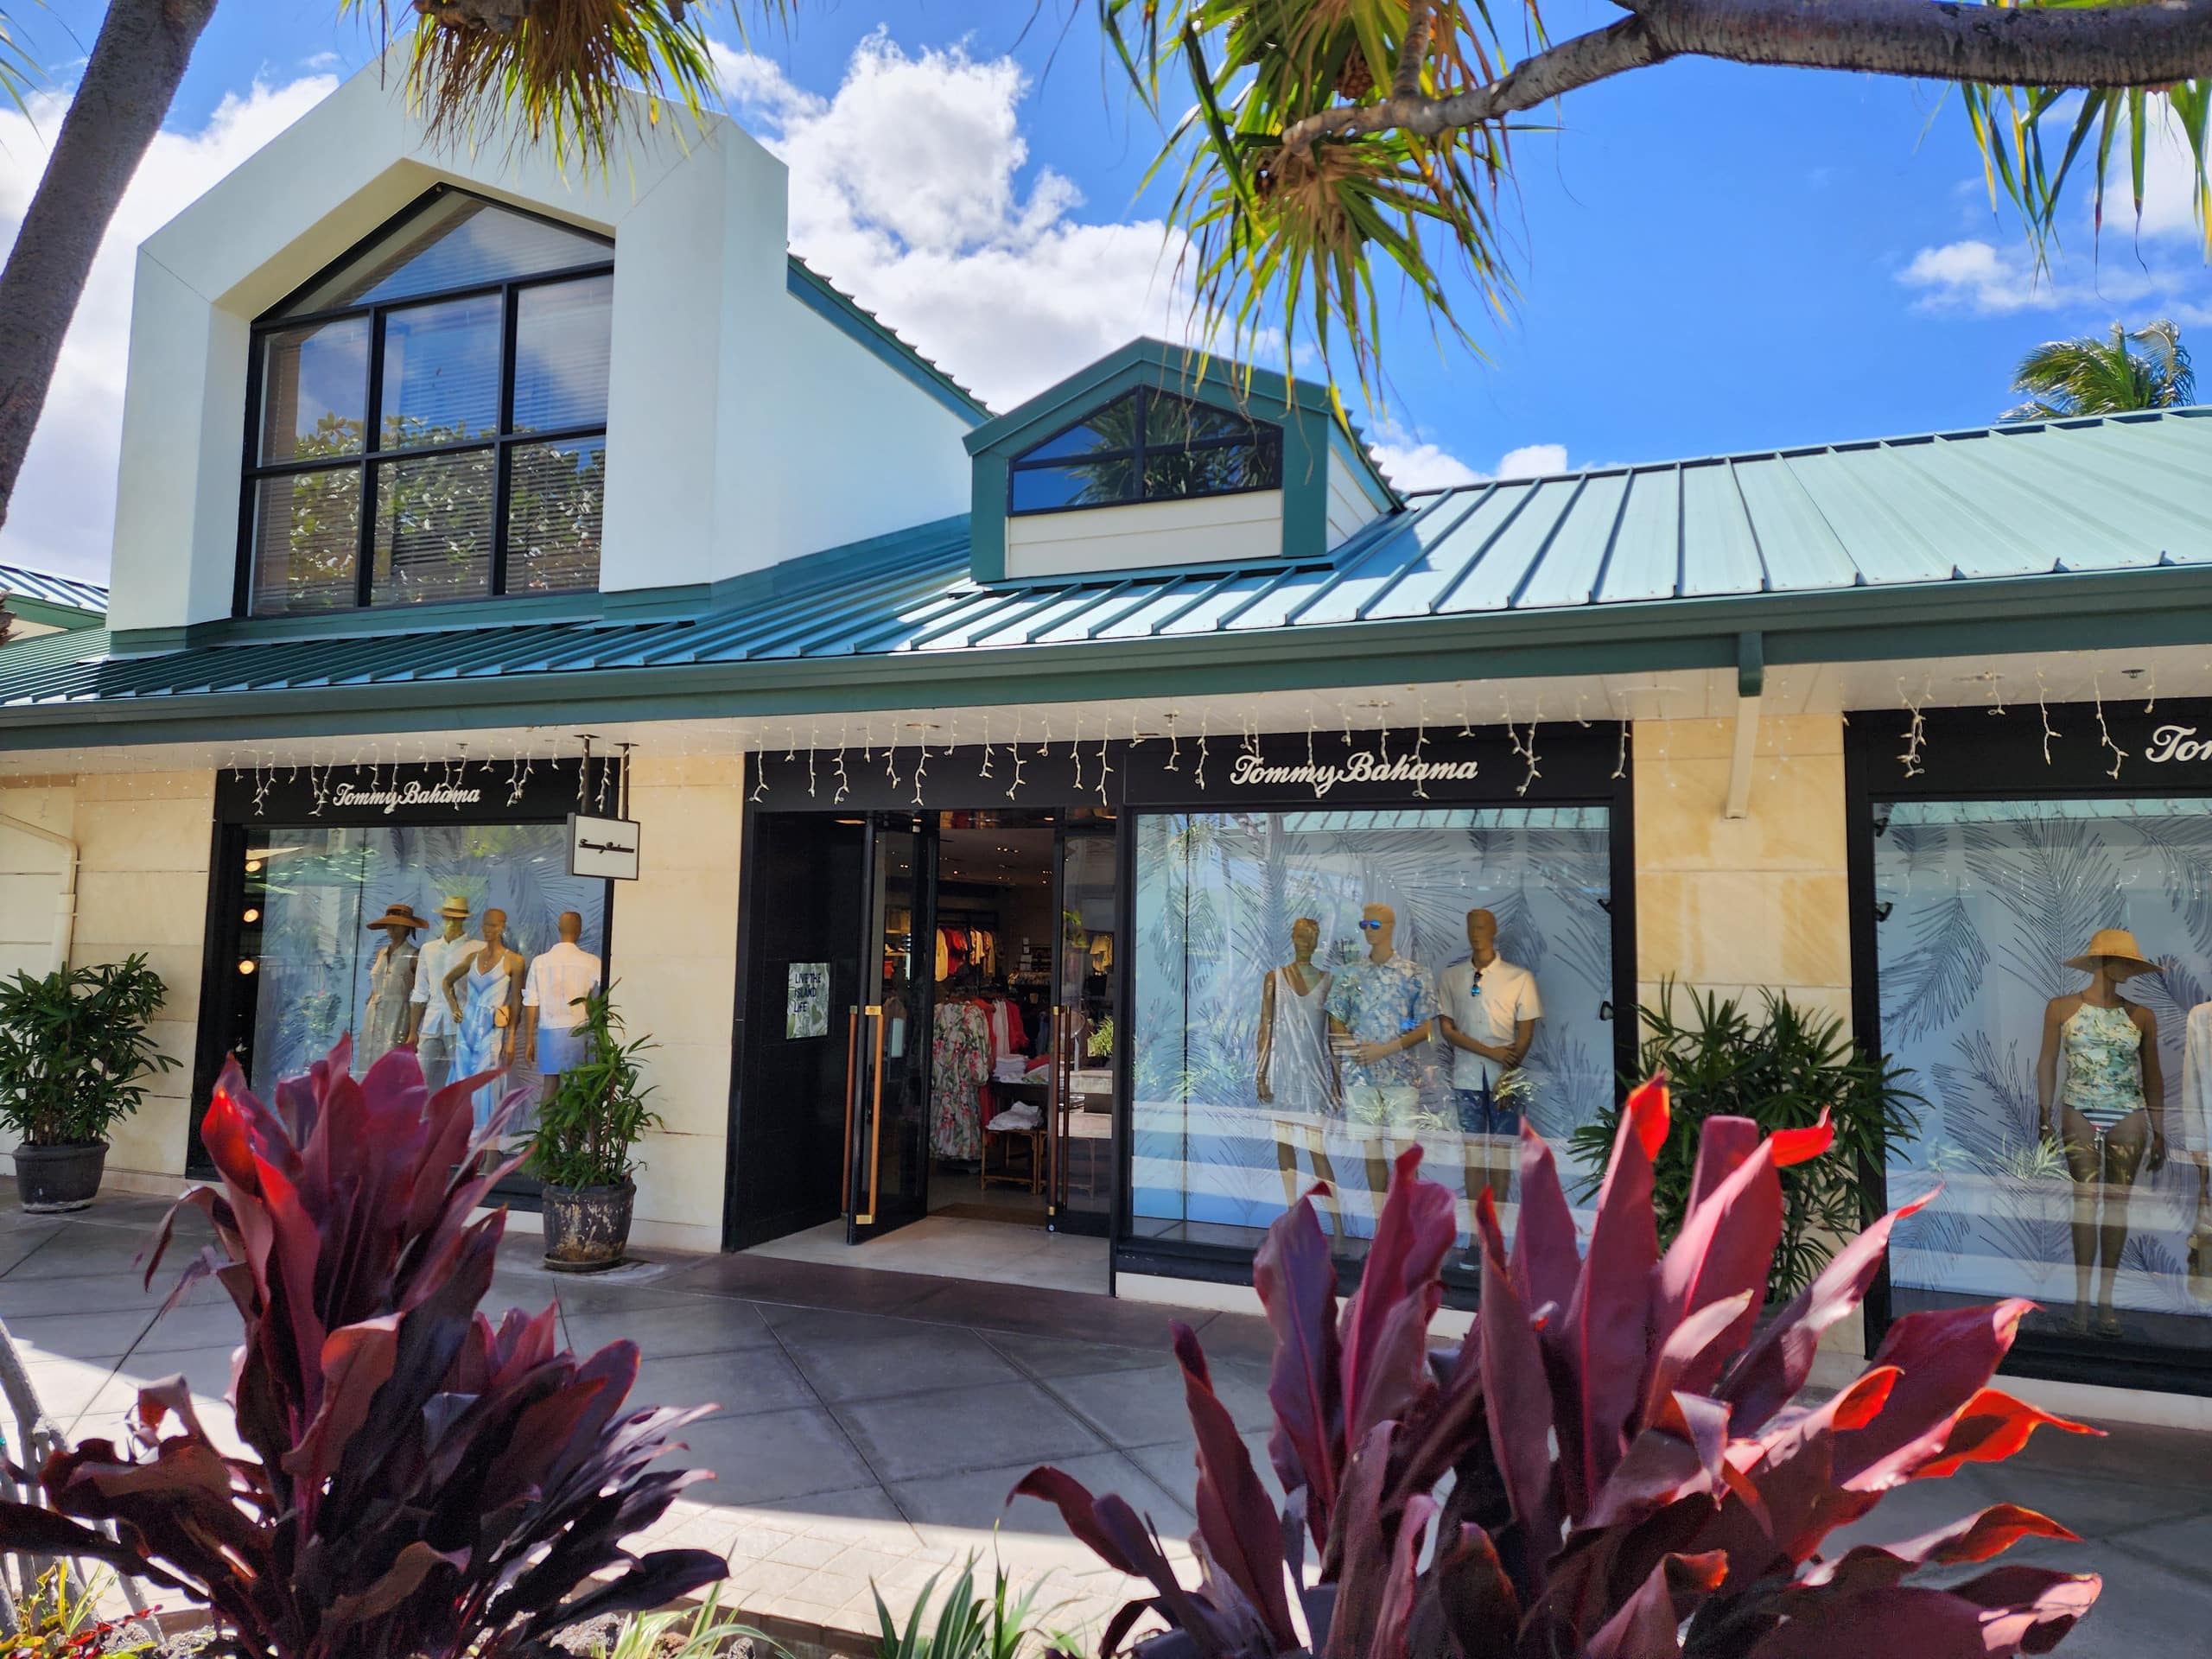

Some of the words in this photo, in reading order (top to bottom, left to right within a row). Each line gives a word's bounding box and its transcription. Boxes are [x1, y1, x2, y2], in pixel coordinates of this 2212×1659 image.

[1230, 754, 1338, 795] Tommy
[1338, 751, 1478, 782] Bahama
[333, 782, 399, 814] Tommy
[398, 780, 480, 804] Bahama
[795, 988, 817, 998] ISLAND
[794, 1001, 807, 1012] LIFE
